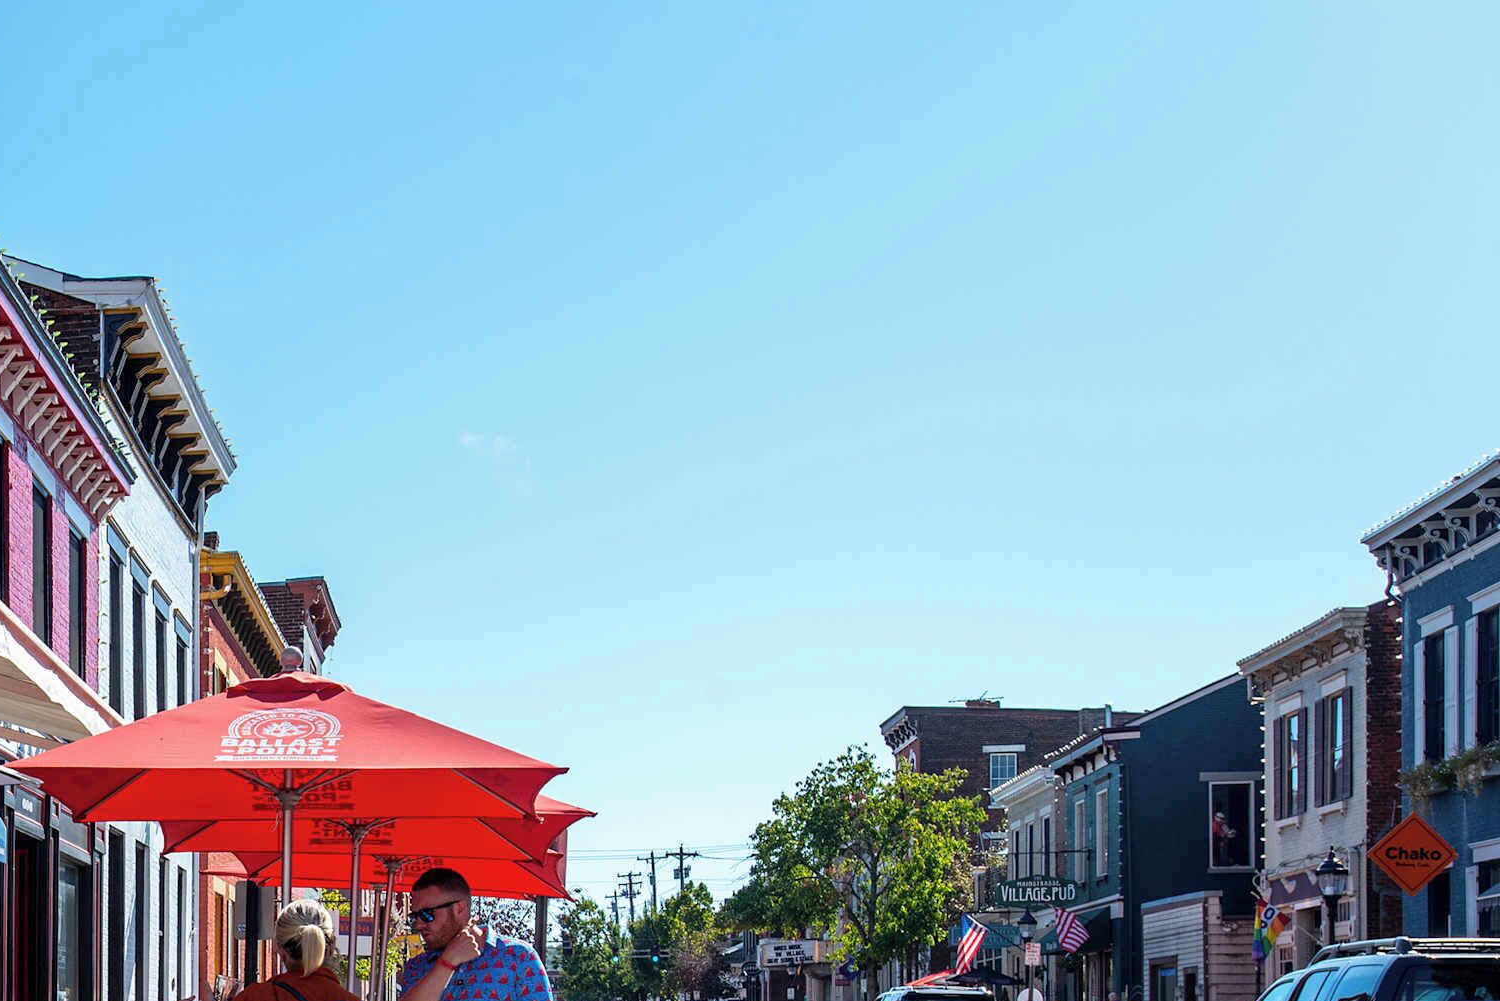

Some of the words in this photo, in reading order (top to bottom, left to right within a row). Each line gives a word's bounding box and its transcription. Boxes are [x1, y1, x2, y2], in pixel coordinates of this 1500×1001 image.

[220, 738, 342, 747] BALLAST
[237, 747, 324, 755] POINT
[1385, 847, 1442, 861] Chako
[1001, 885, 1051, 902] VILLAGE
[1052, 884, 1076, 901] PUB
